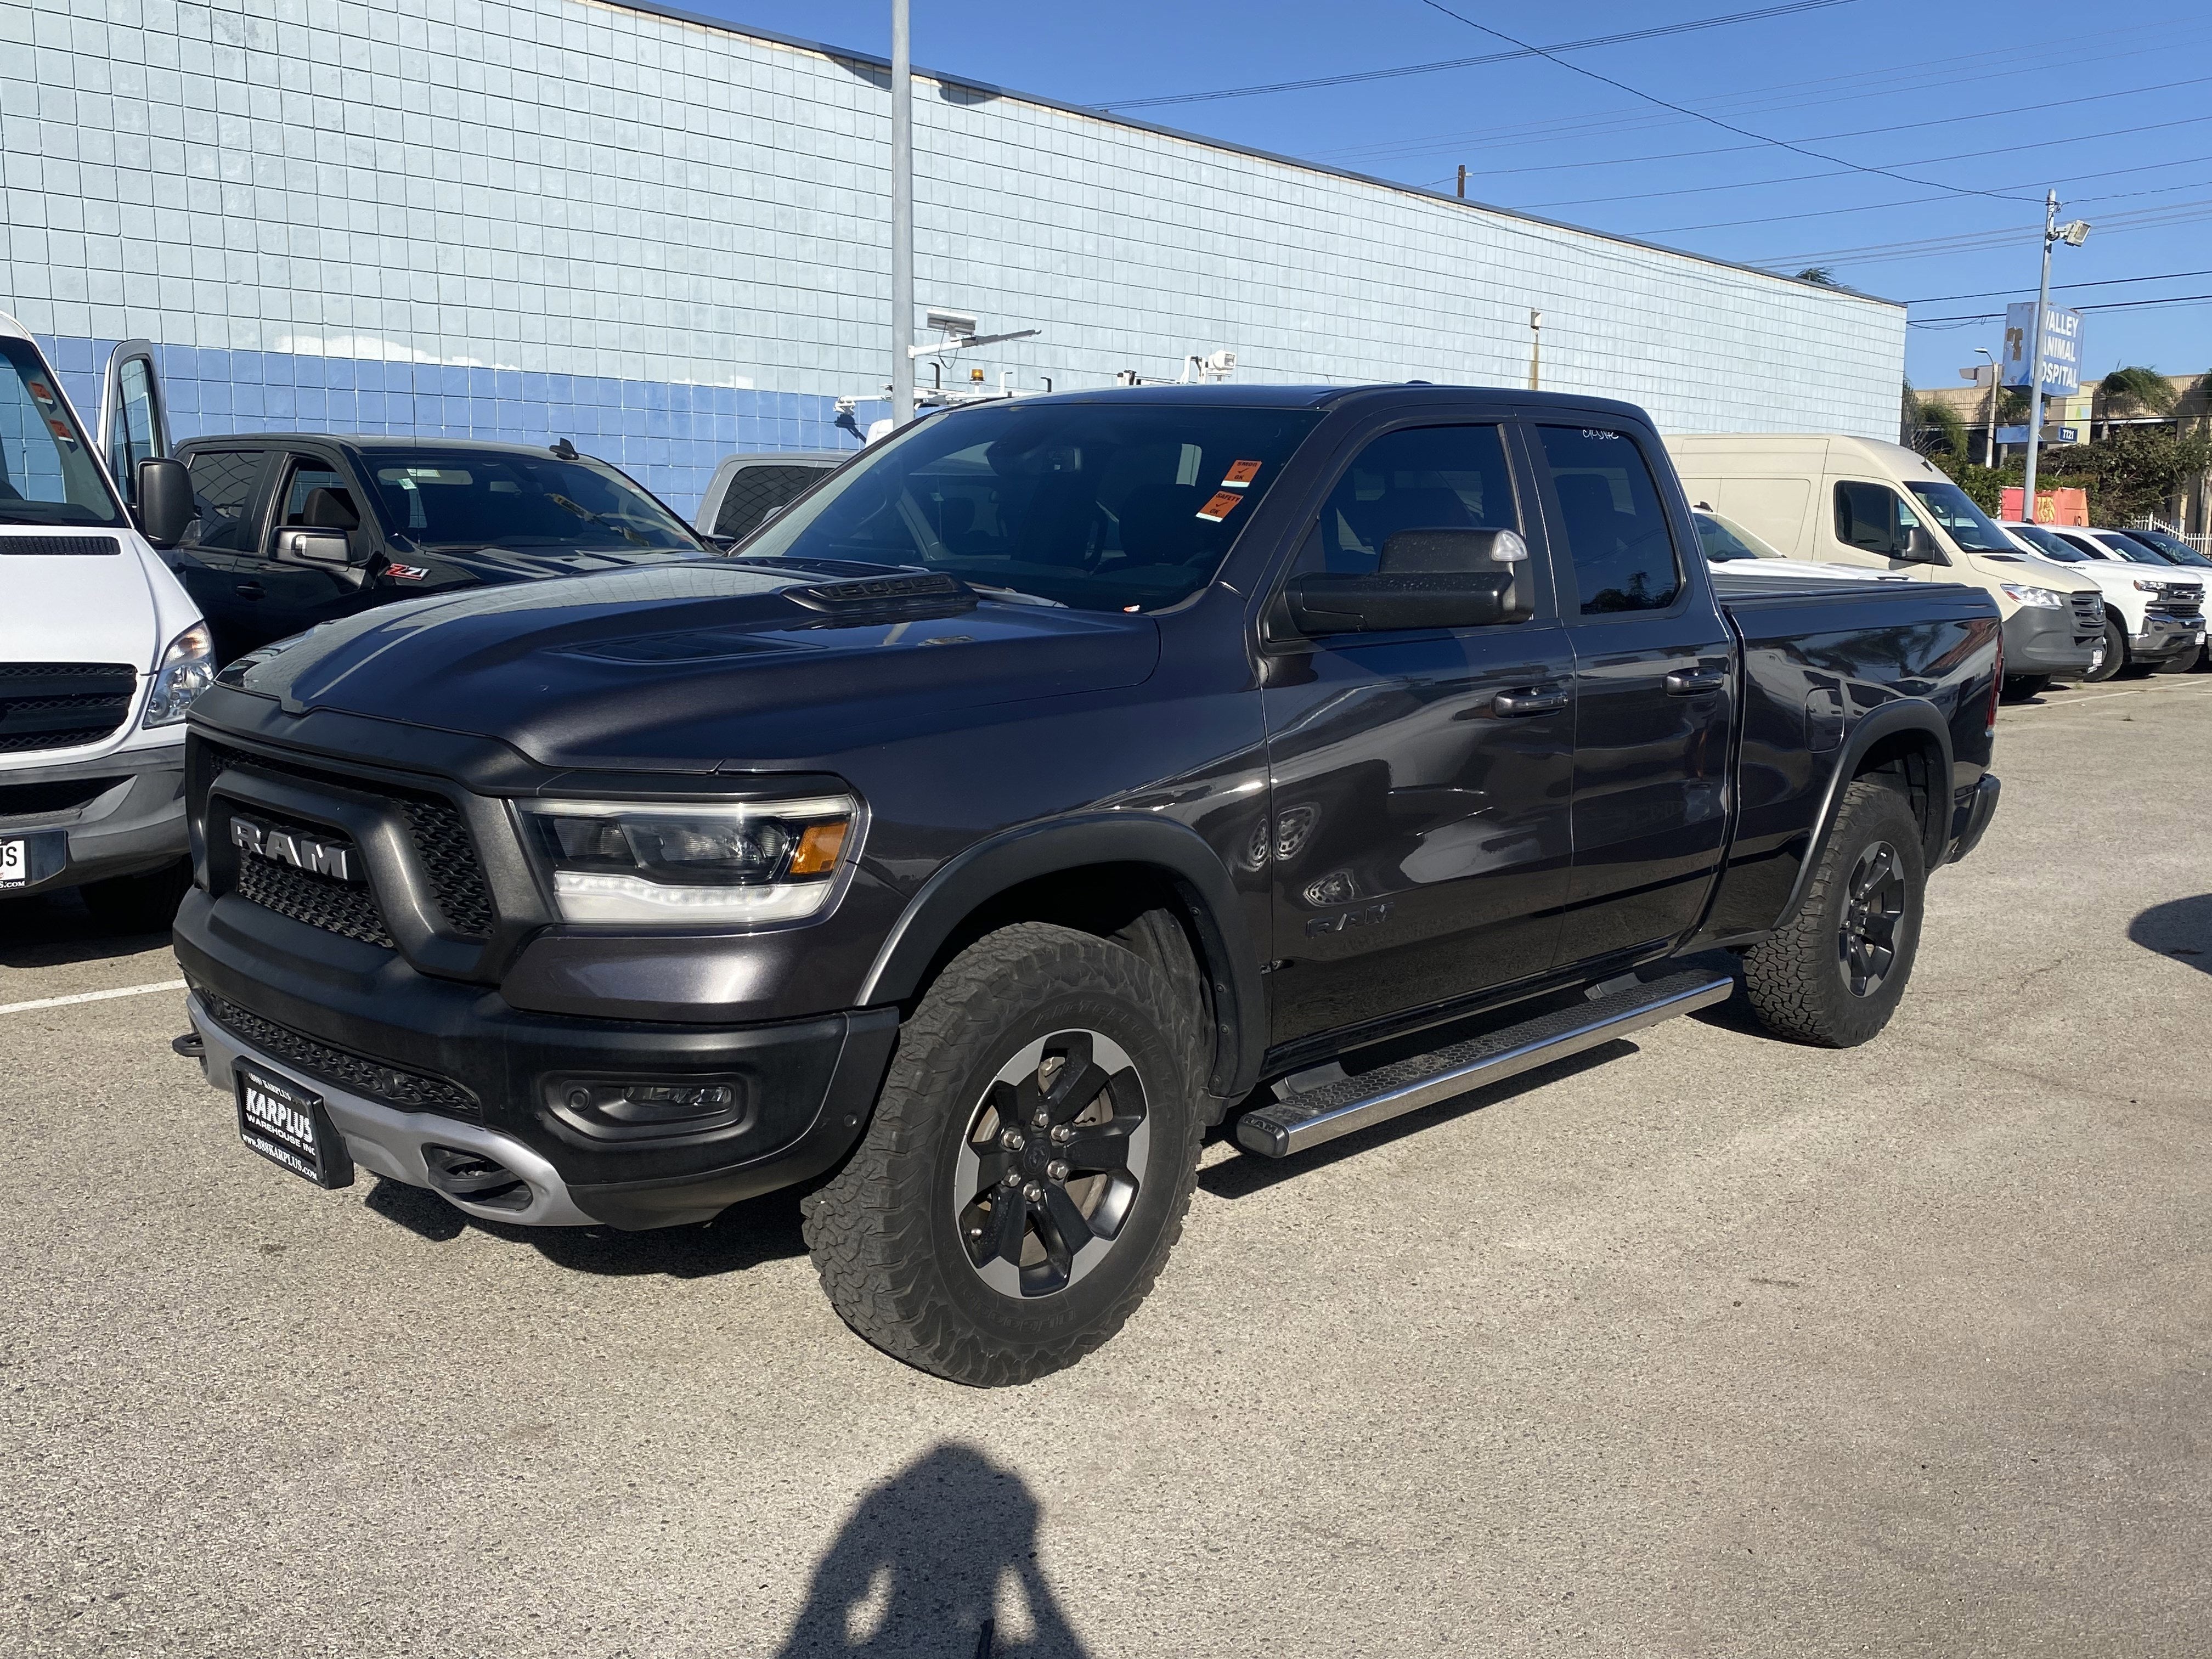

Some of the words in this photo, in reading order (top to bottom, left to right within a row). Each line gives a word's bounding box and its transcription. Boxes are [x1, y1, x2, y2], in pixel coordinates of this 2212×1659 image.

[2032, 358, 2078, 388] OSPITAL
[2063, 429, 2074, 440] 7721
[1216, 493, 1241, 501] SAFETY
[230, 816, 348, 881] RAM
[246, 1087, 313, 1143] KARPLUS
[246, 1113, 301, 1148] WAREHOUSE
